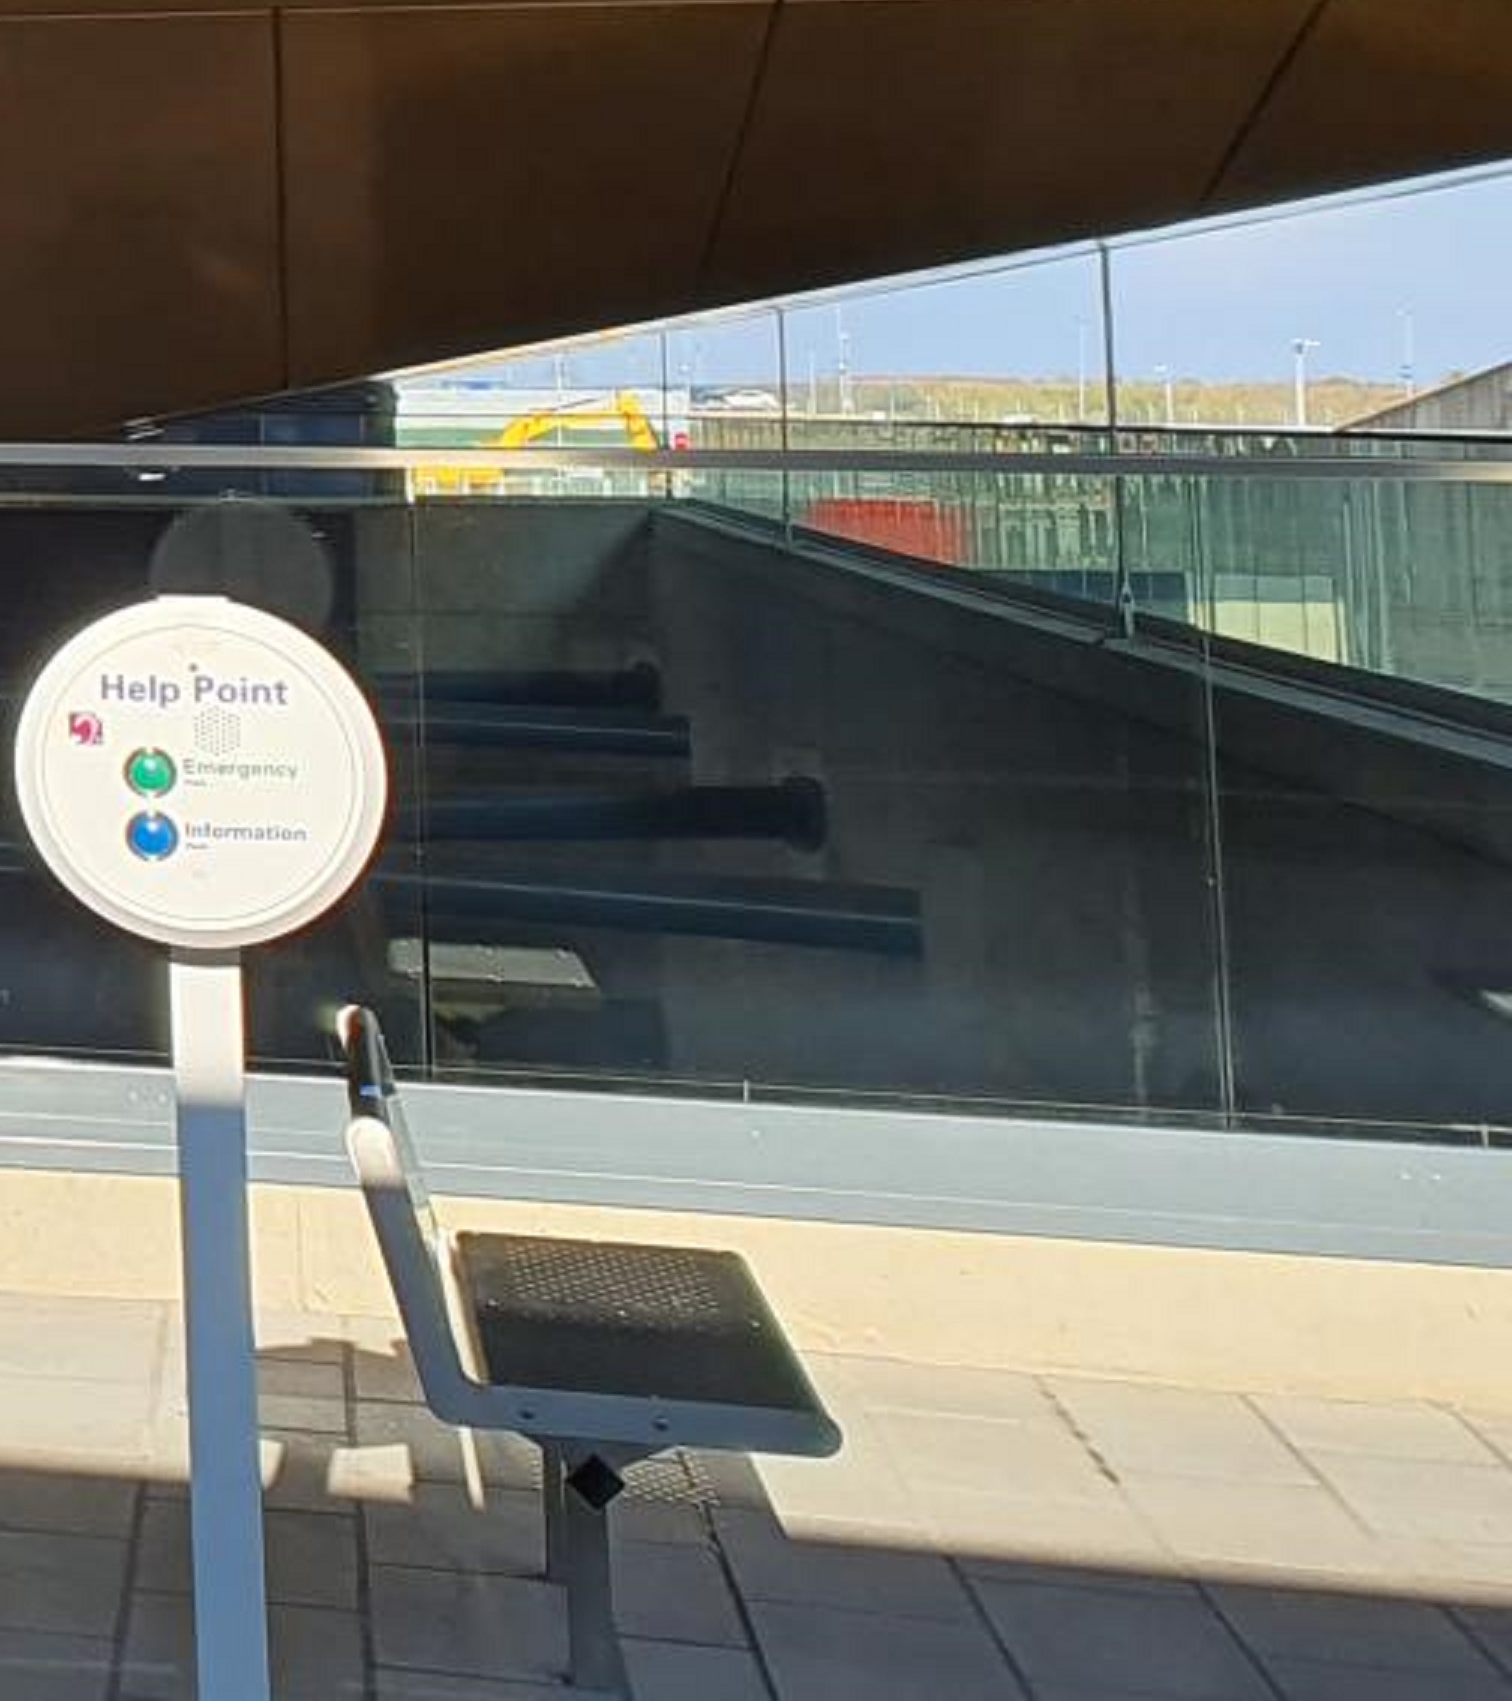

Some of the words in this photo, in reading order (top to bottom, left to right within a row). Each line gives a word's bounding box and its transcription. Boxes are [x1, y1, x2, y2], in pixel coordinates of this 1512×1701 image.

[100, 673, 181, 708] Help
[194, 675, 289, 706] Point
[182, 758, 298, 780] Emergency
[184, 822, 307, 841] Information
